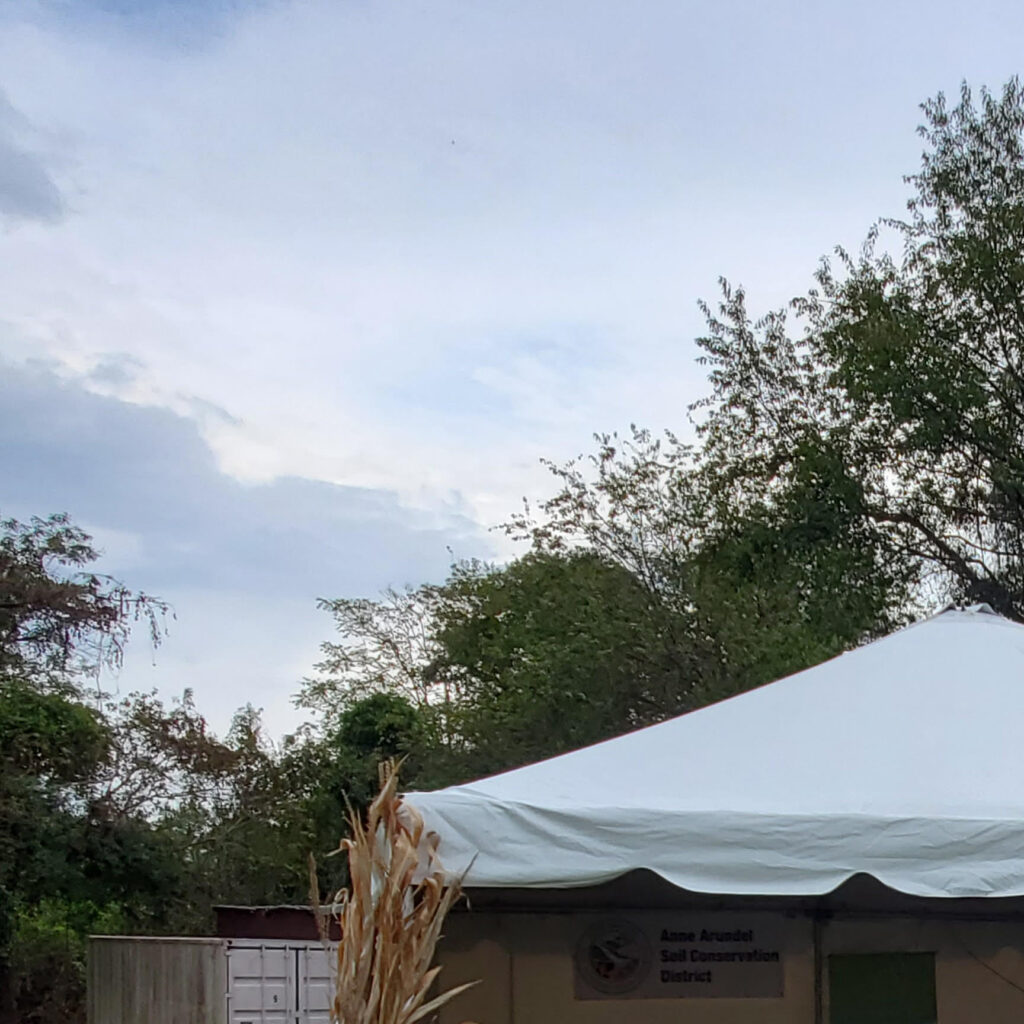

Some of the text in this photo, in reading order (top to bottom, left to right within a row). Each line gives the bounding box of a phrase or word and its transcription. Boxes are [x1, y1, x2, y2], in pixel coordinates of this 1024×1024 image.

[661, 929, 753, 942] Anne Arundel
[661, 949, 779, 963] Soil Conservation
[661, 969, 712, 983] District
